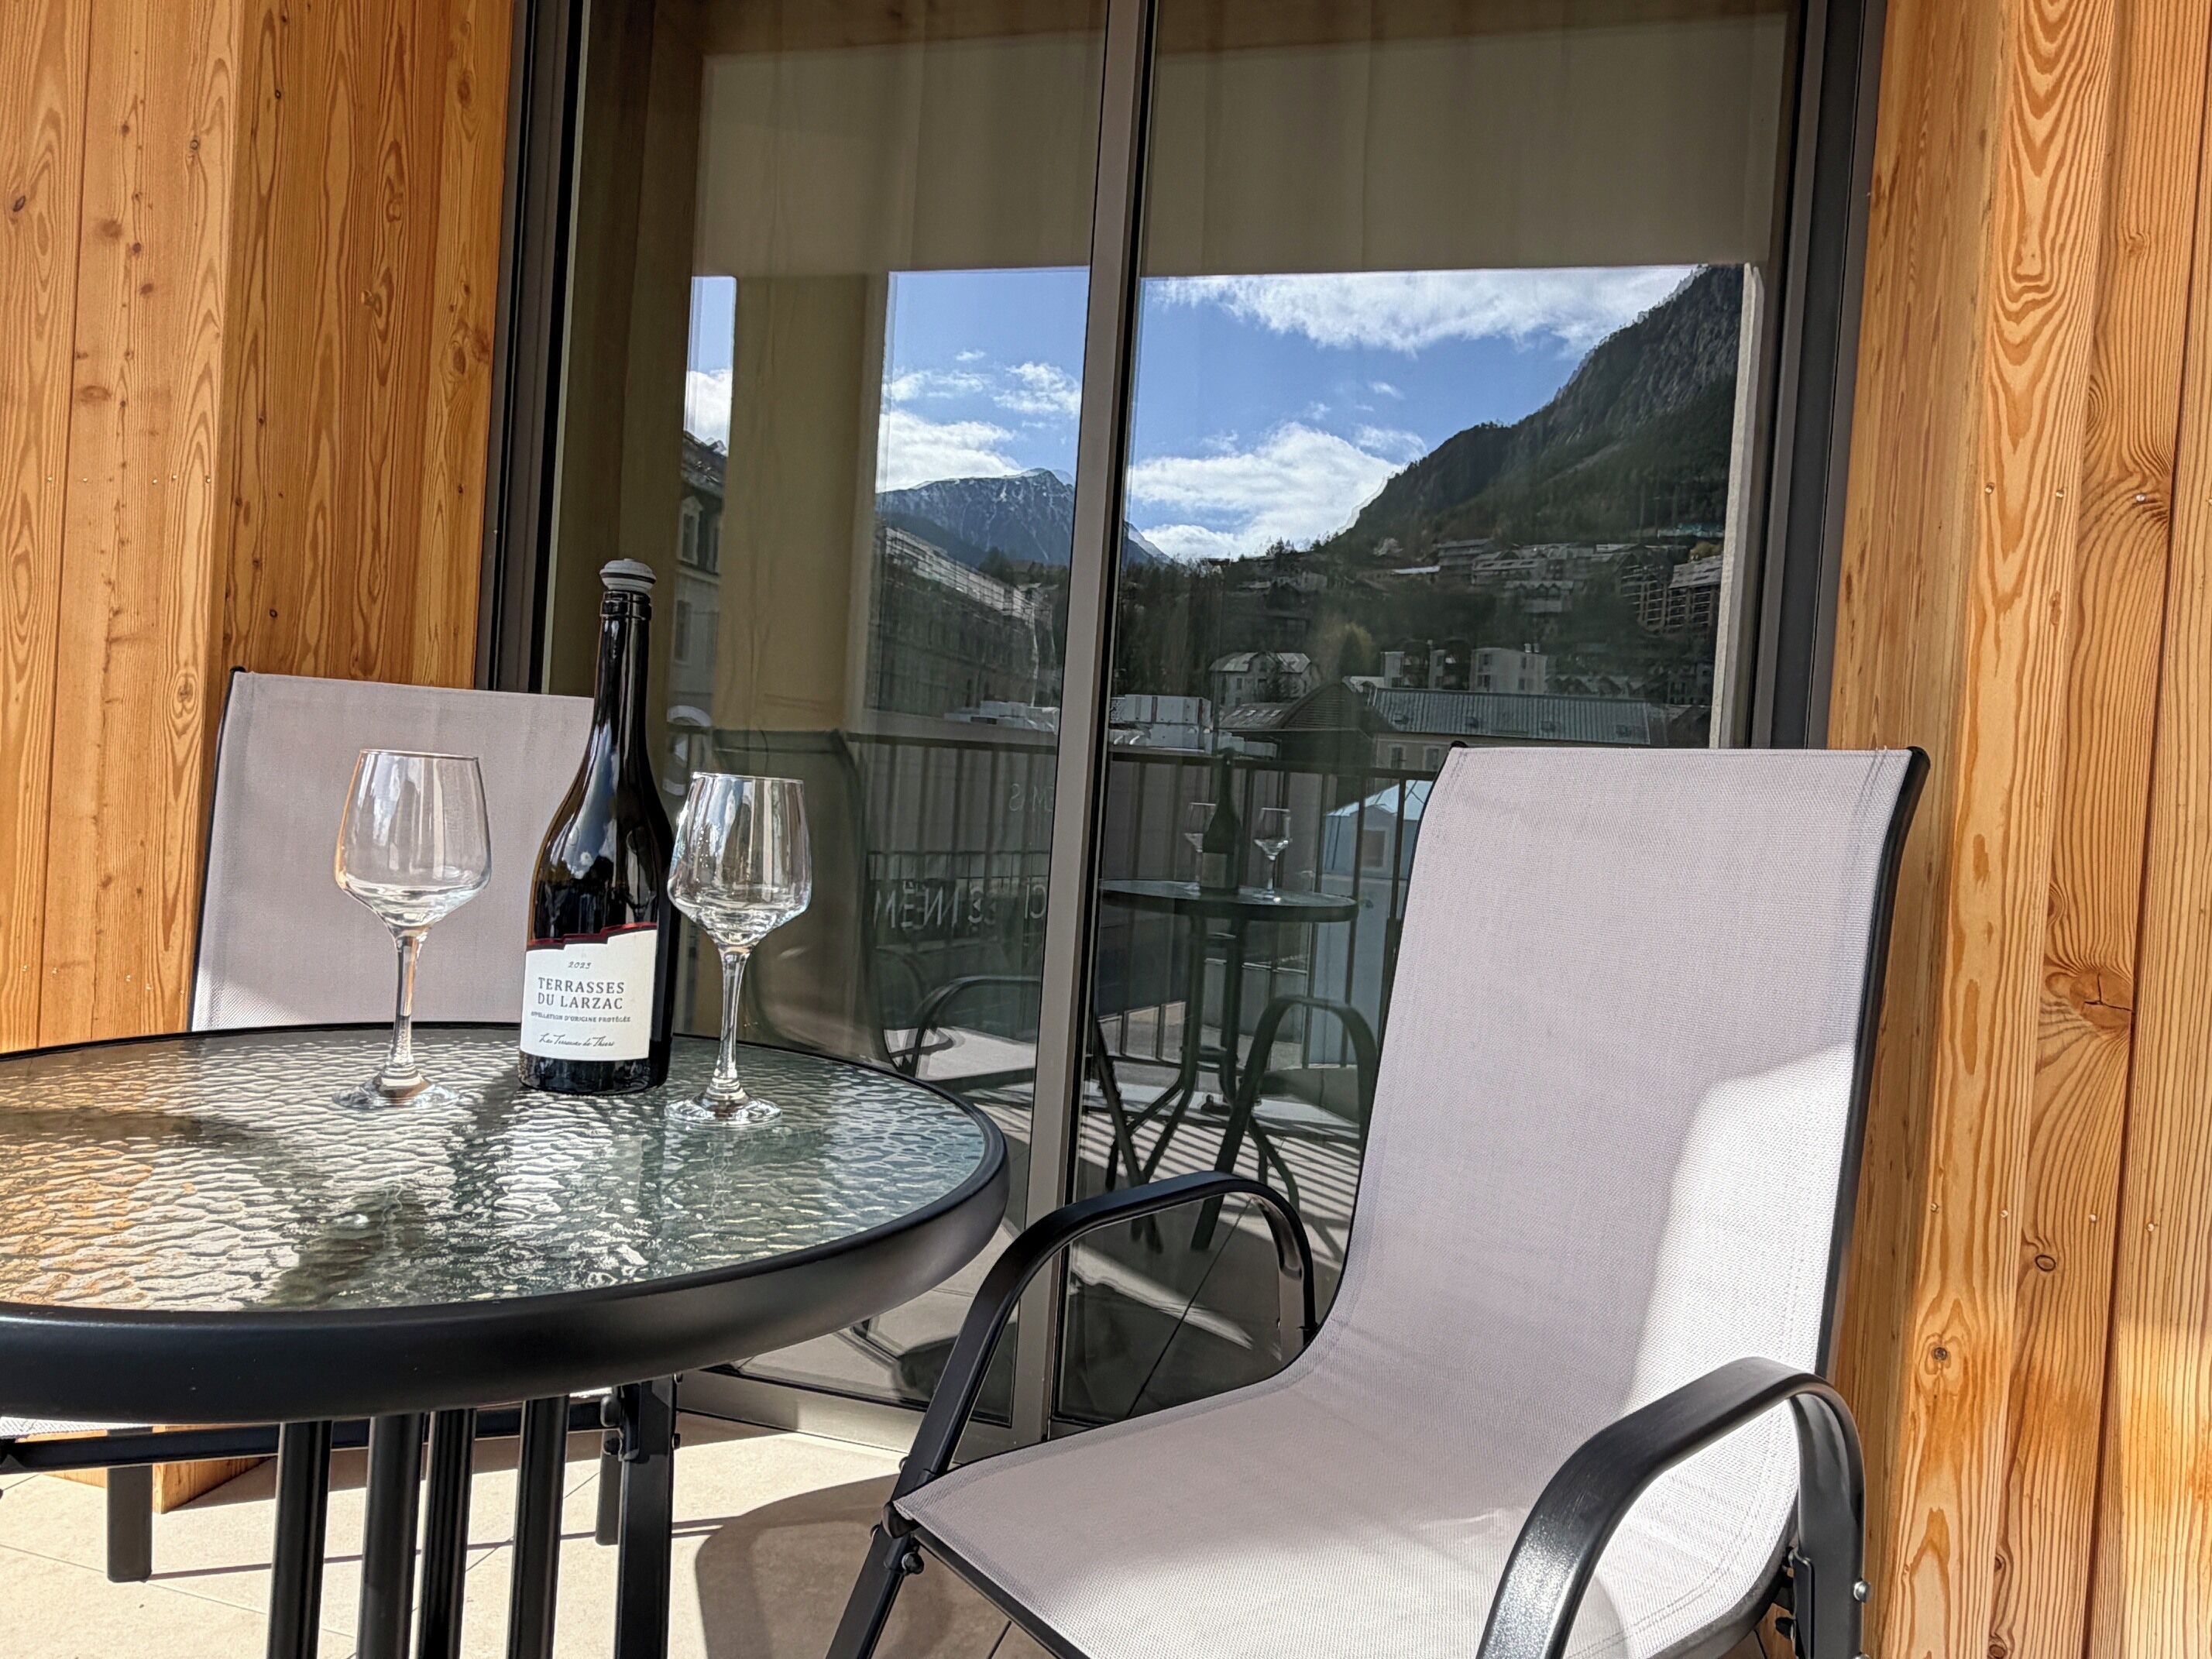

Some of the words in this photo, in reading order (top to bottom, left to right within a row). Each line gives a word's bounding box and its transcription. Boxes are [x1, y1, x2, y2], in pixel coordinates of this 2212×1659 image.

[538, 977, 625, 994] TERRASSES
[538, 992, 555, 1006] DU
[561, 995, 623, 1010] LARZAC
